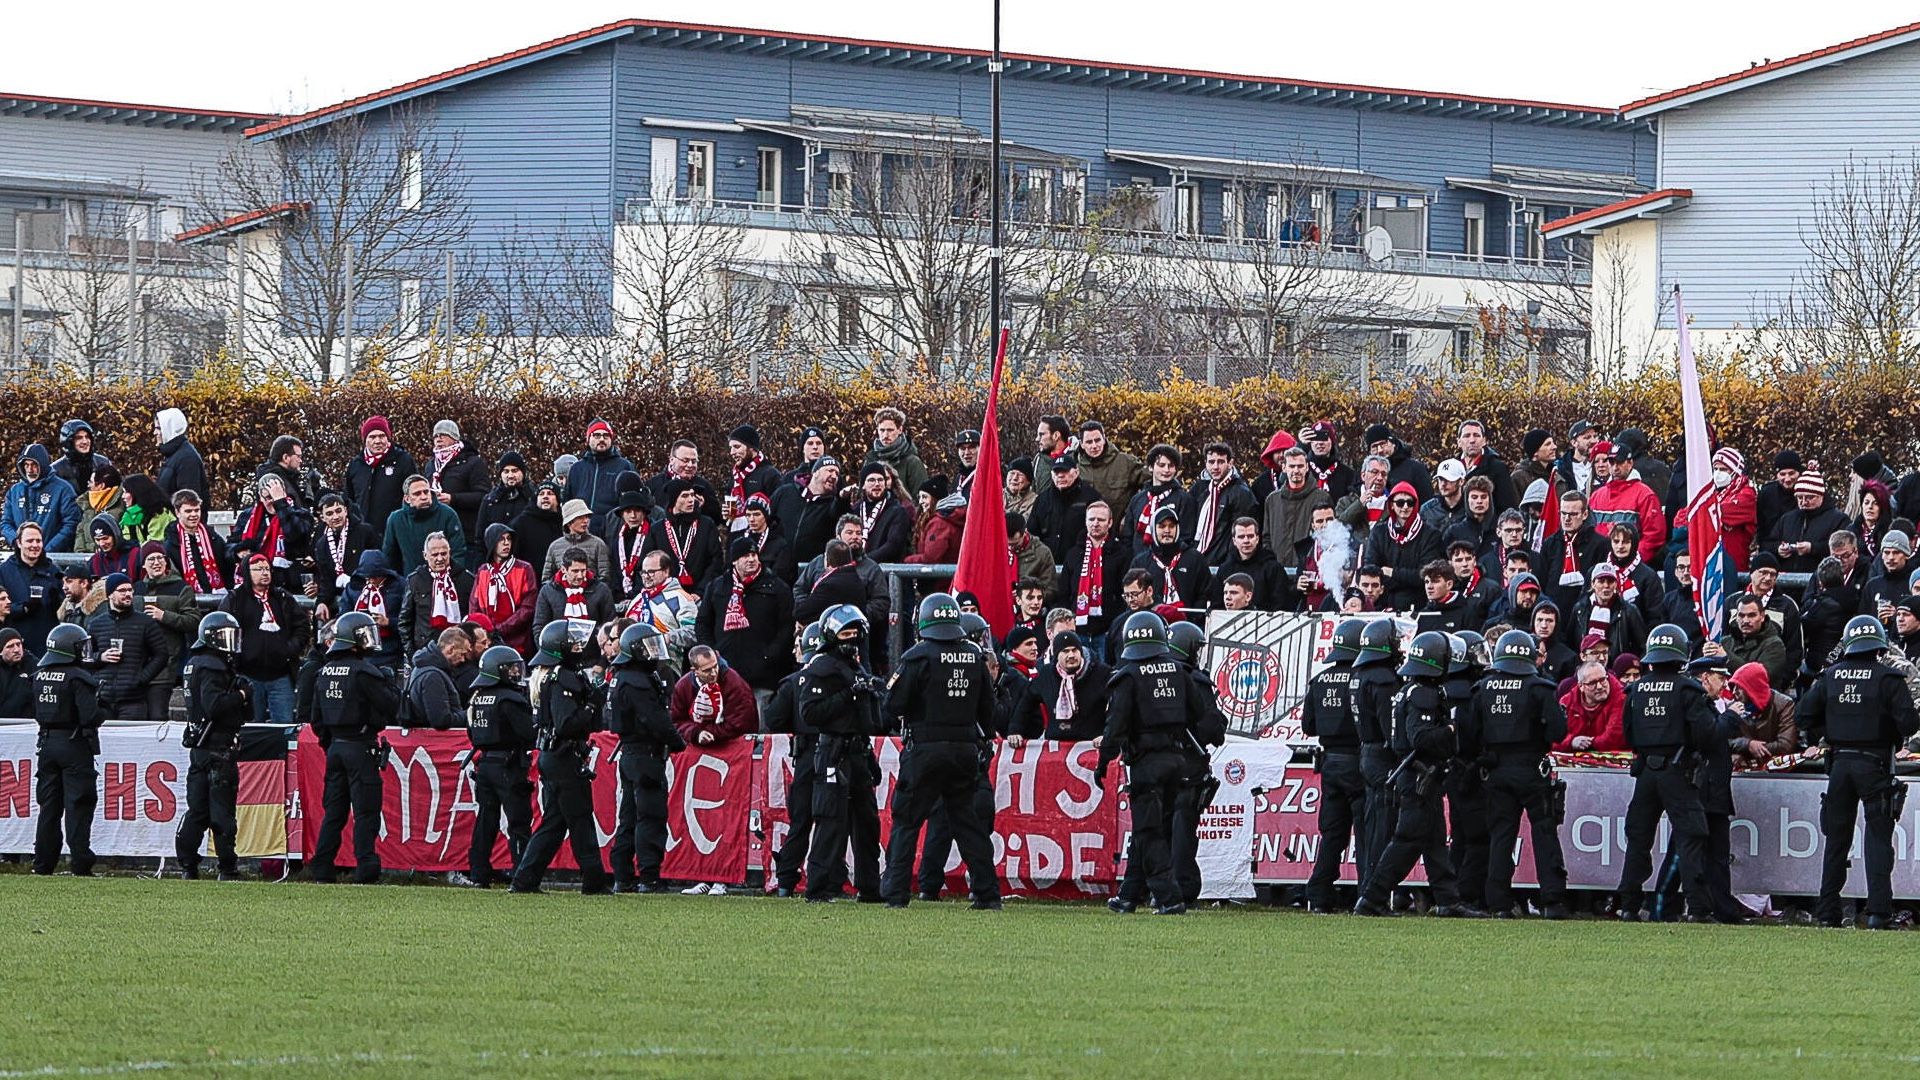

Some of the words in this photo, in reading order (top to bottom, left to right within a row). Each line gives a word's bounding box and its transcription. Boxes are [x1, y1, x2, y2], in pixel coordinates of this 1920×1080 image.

[1128, 628, 1153, 638] 6431
[1849, 625, 1876, 637] 6433
[1505, 644, 1530, 655] 6433
[941, 653, 976, 663] POLIZEI
[322, 666, 350, 676] POLIZEI
[953, 669, 965, 678] BY
[1140, 662, 1177, 675] POLIZEI
[36, 671, 65, 682] POLIZEI
[1318, 673, 1350, 683] POLIZEI
[1835, 669, 1872, 679] POLIZEI
[330, 681, 339, 689] BY
[947, 679, 969, 688] 6430
[1157, 678, 1169, 688] BY
[1486, 680, 1522, 690] POLIZEI
[1638, 682, 1674, 692] POLIZEI
[43, 685, 53, 694] BY
[1153, 687, 1176, 697] 6431
[1326, 688, 1337, 697] BY
[1844, 684, 1857, 693] BY
[39, 694, 57, 703] 6431
[326, 690, 343, 698] 6432
[1839, 693, 1862, 703] 6433
[474, 696, 496, 704] OLIZEI
[1322, 698, 1342, 707] 6433
[1496, 695, 1507, 704] BY
[1649, 697, 1660, 707] BY
[1491, 704, 1512, 714] 6433
[1644, 707, 1666, 716] 6433
[1198, 830, 1232, 840] IKOTS
